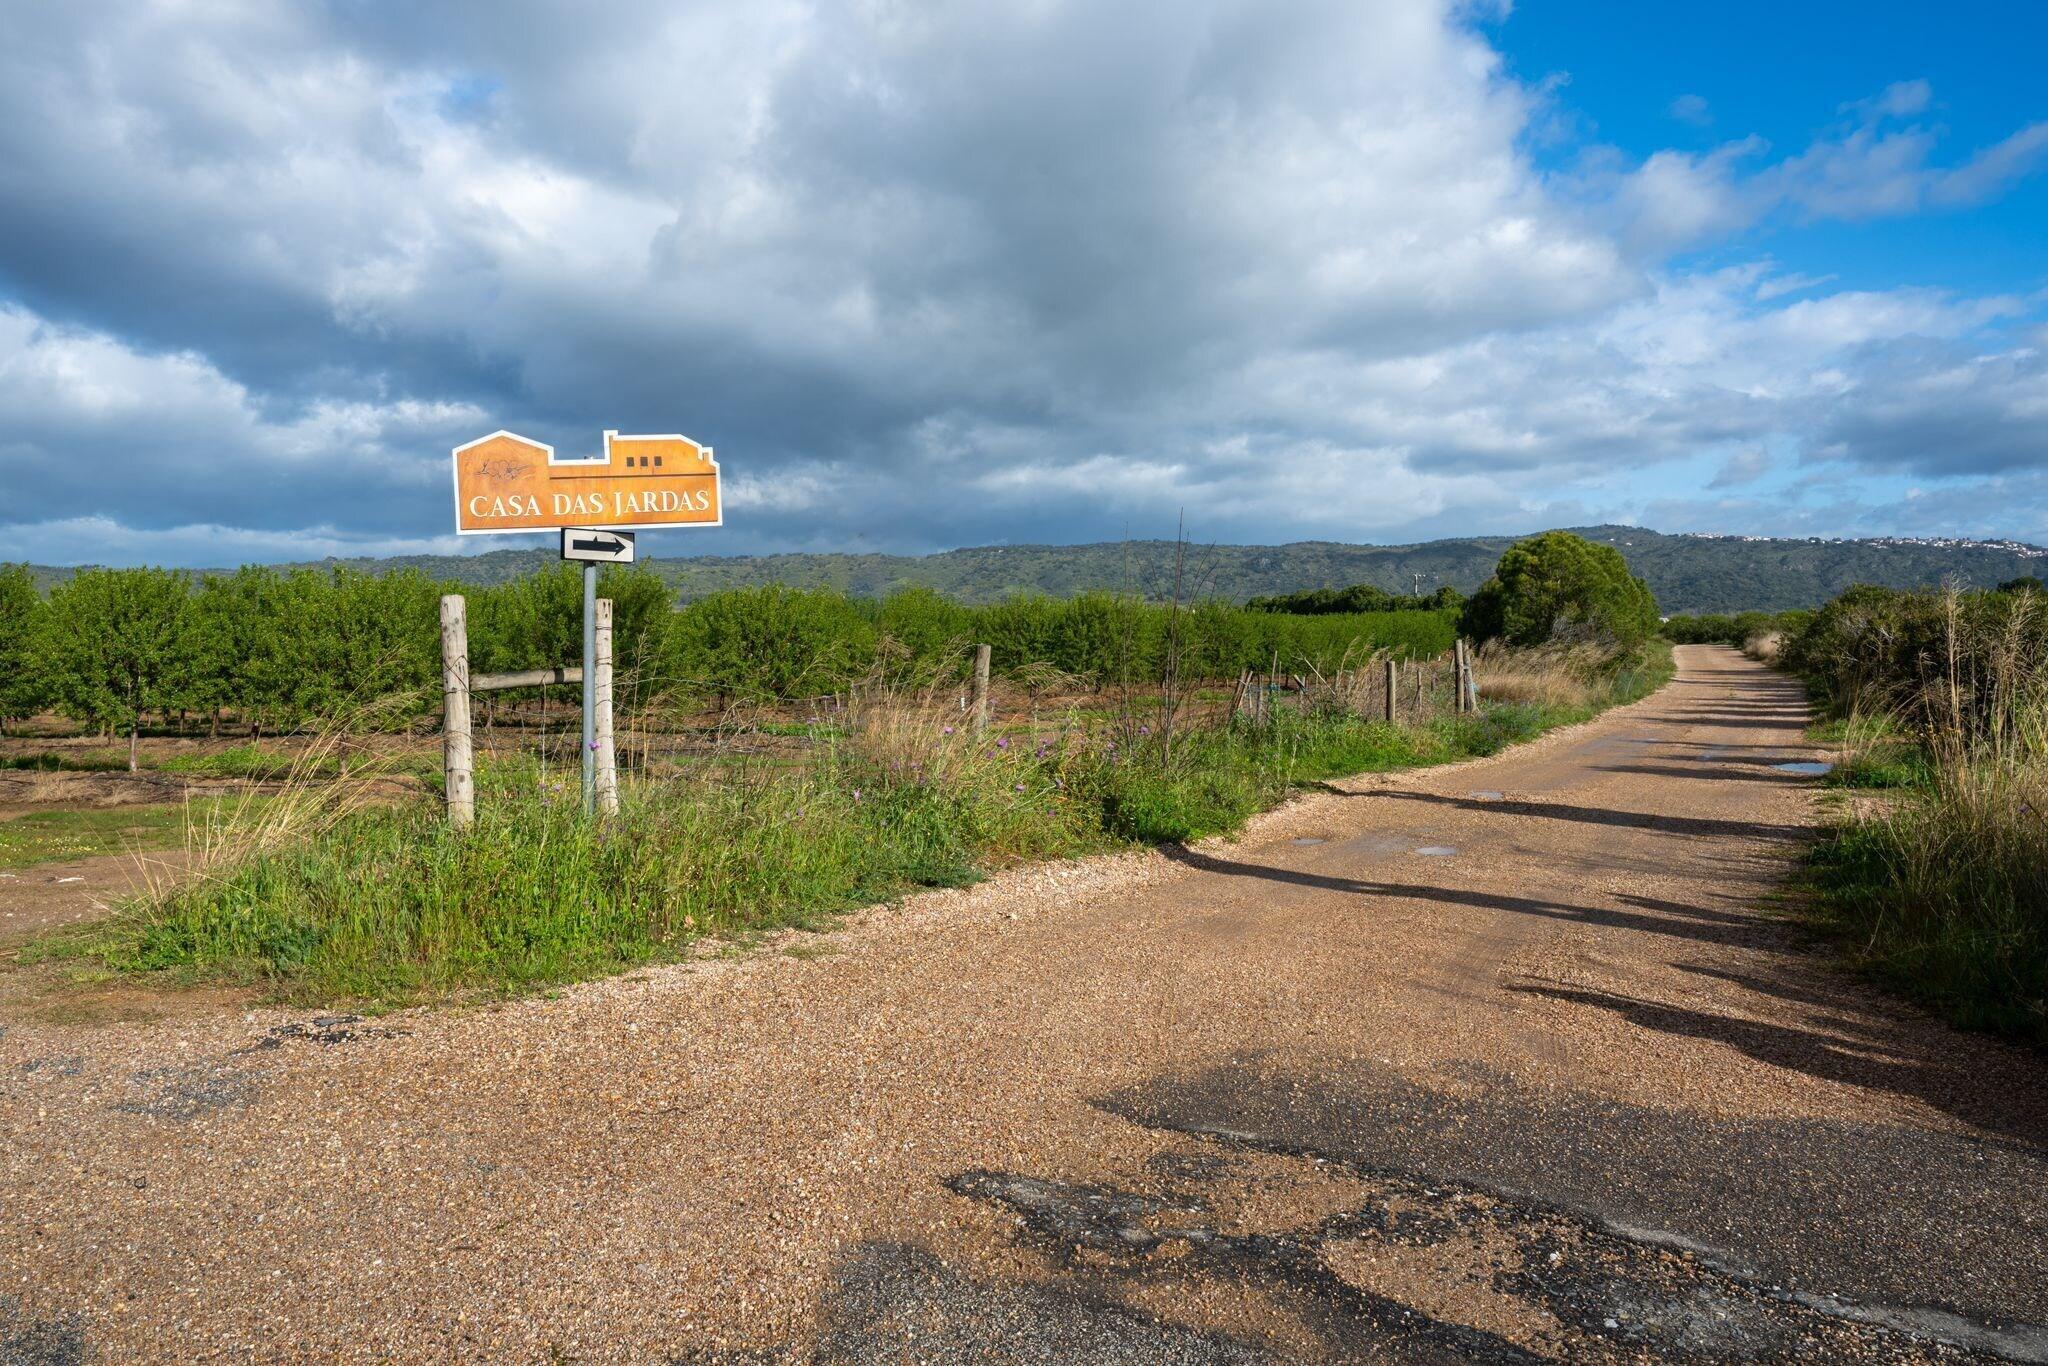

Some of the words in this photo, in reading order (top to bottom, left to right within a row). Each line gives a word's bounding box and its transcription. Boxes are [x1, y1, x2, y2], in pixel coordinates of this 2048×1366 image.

[470, 495, 542, 517] CASA
[553, 493, 603, 515] DAS
[614, 490, 710, 517] JARDAS
